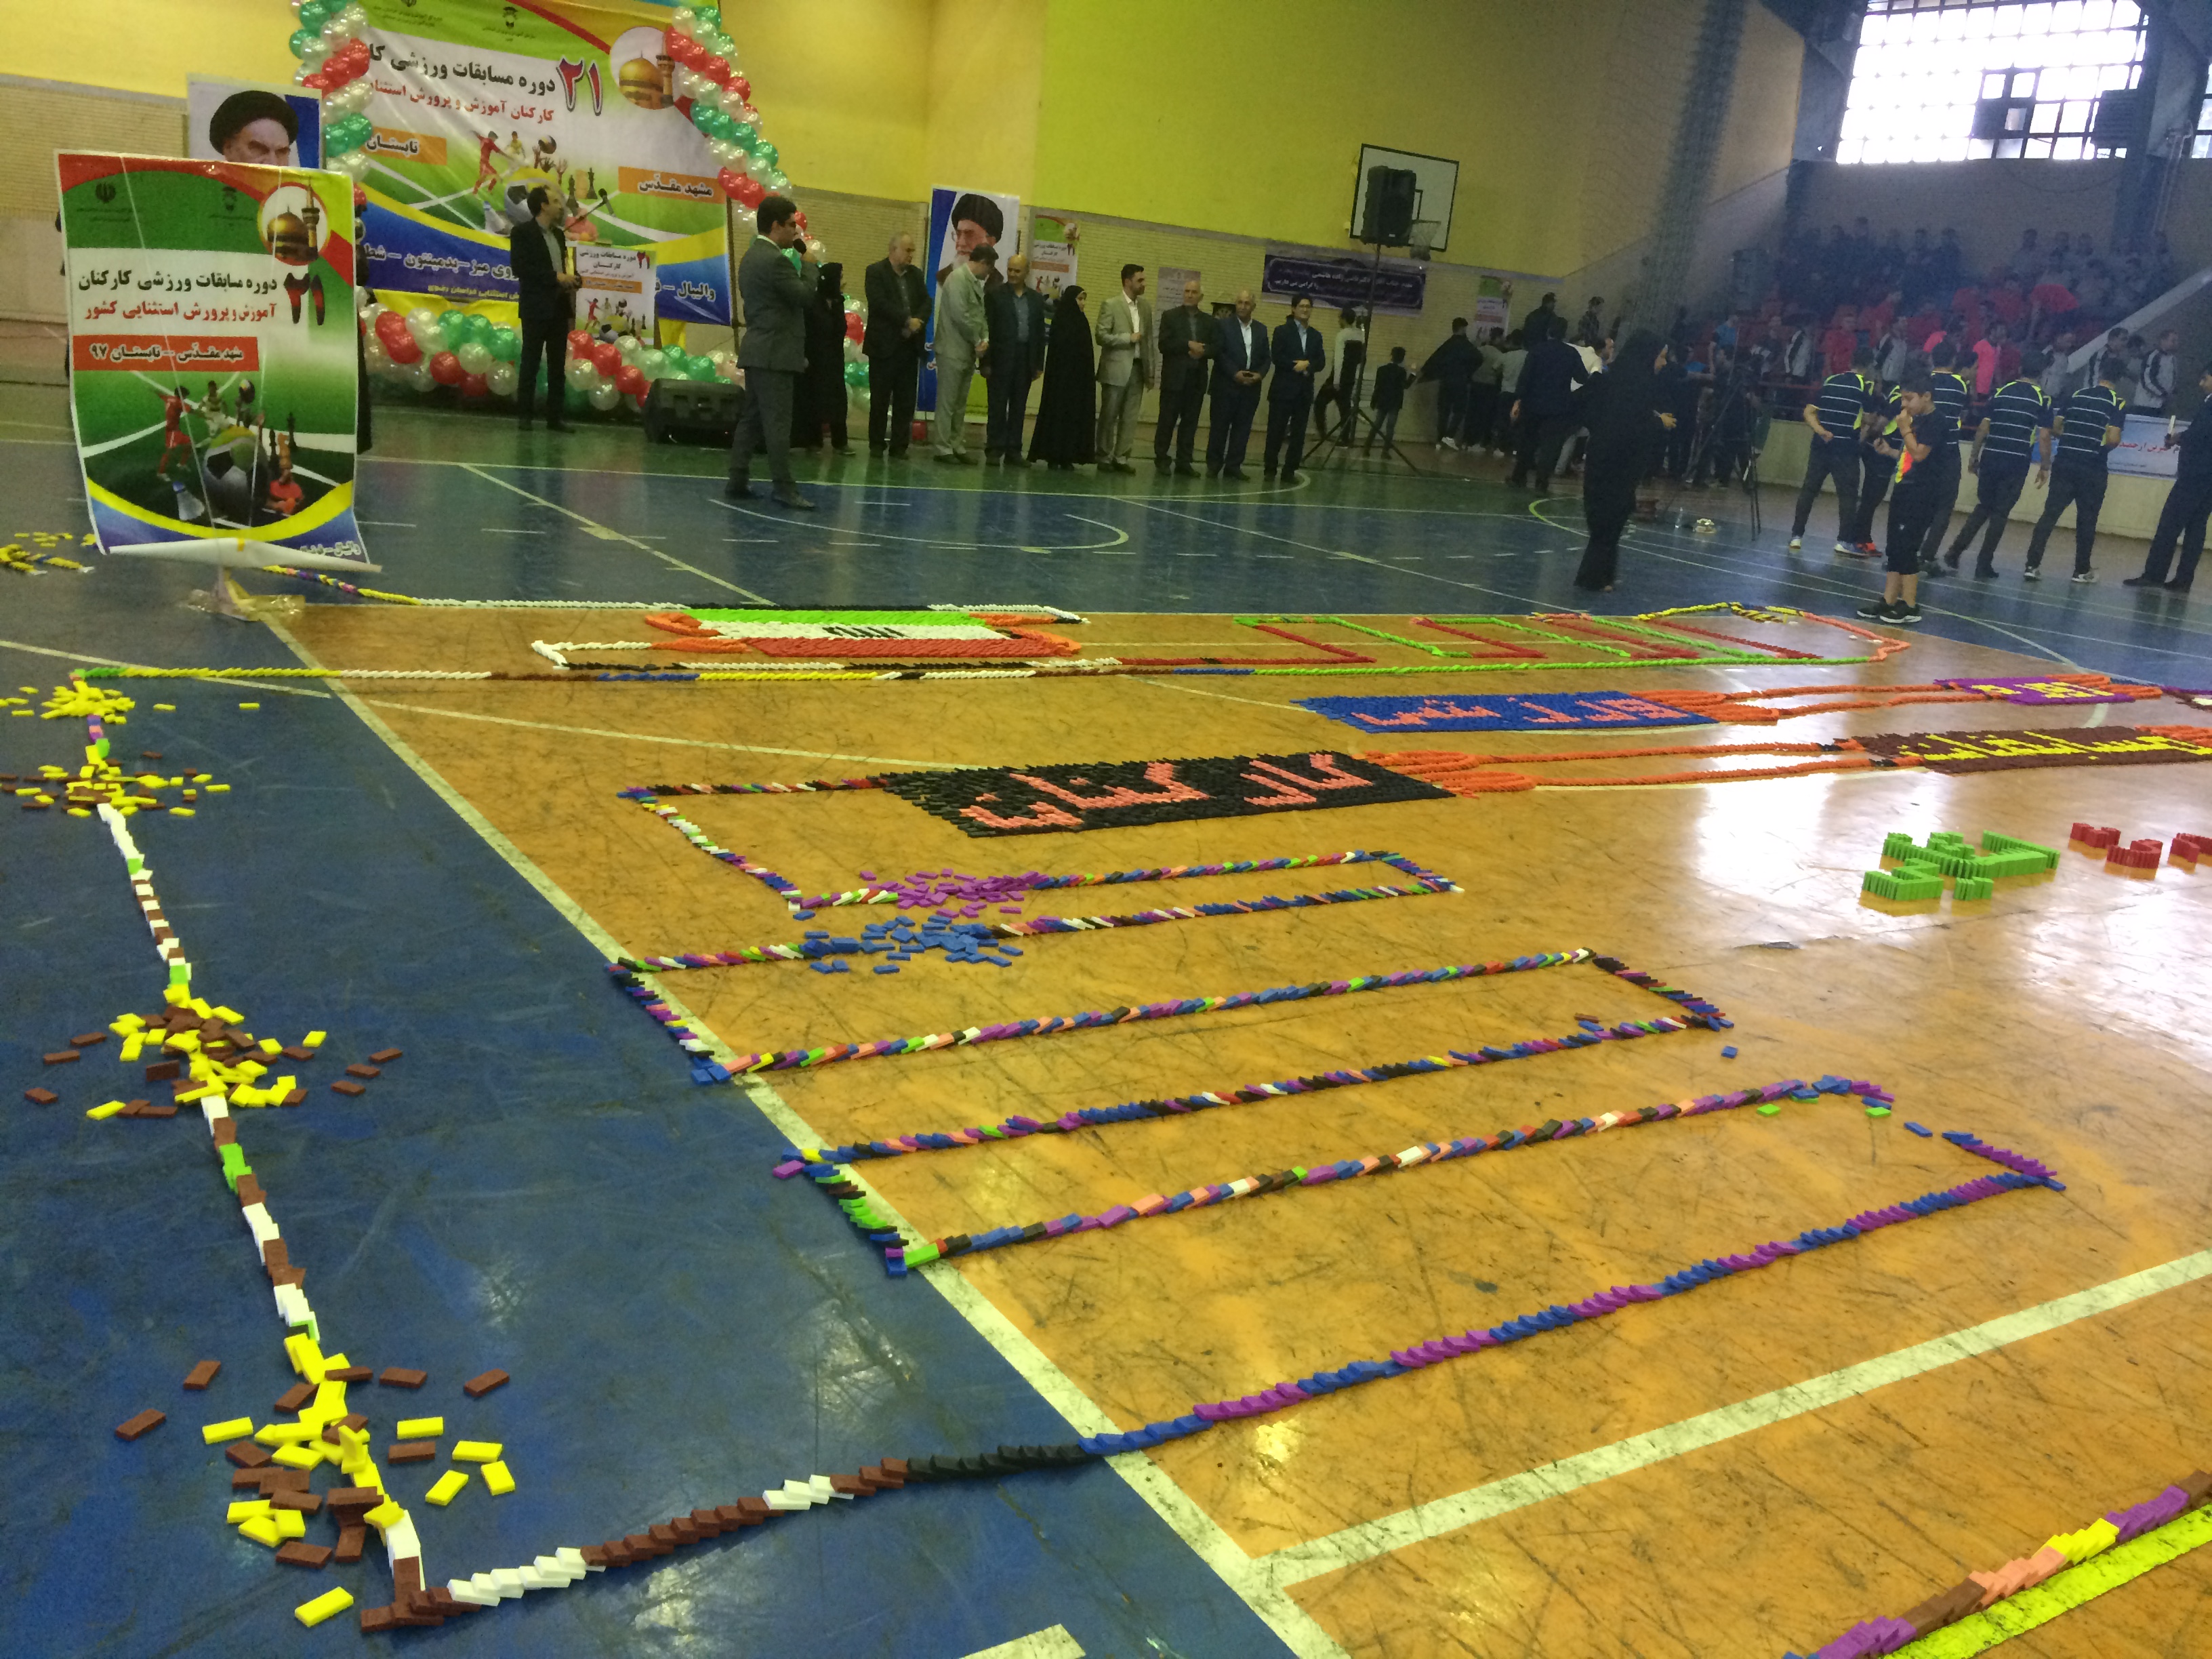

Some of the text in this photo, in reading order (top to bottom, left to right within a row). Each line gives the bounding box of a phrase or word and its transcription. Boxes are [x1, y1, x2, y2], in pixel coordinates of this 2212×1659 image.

[390, 52, 448, 79] ورزشی
[453, 62, 514, 86] مسابقات
[519, 74, 555, 96] دوره
[556, 55, 602, 116] ۲۱
[410, 87, 451, 110] پرورش
[464, 97, 508, 116] آموزش
[510, 105, 554, 124] کارکنان
[366, 134, 418, 157] تابستان
[684, 182, 714, 197] مشهد
[469, 260, 490, 276] میز
[79, 270, 325, 326] ۲۱ دوره مسابقات ورزشی کارکنان
[678, 281, 716, 302] والیبال
[84, 300, 118, 320] کشور
[122, 300, 179, 320] استثنایی
[184, 302, 230, 322] پرورش
[239, 303, 276, 322] آموزش
[89, 343, 108, 361] ۹۷
[111, 344, 161, 363] تابستان
[220, 347, 243, 363] مشهد
[958, 751, 1374, 829] کارکنان
